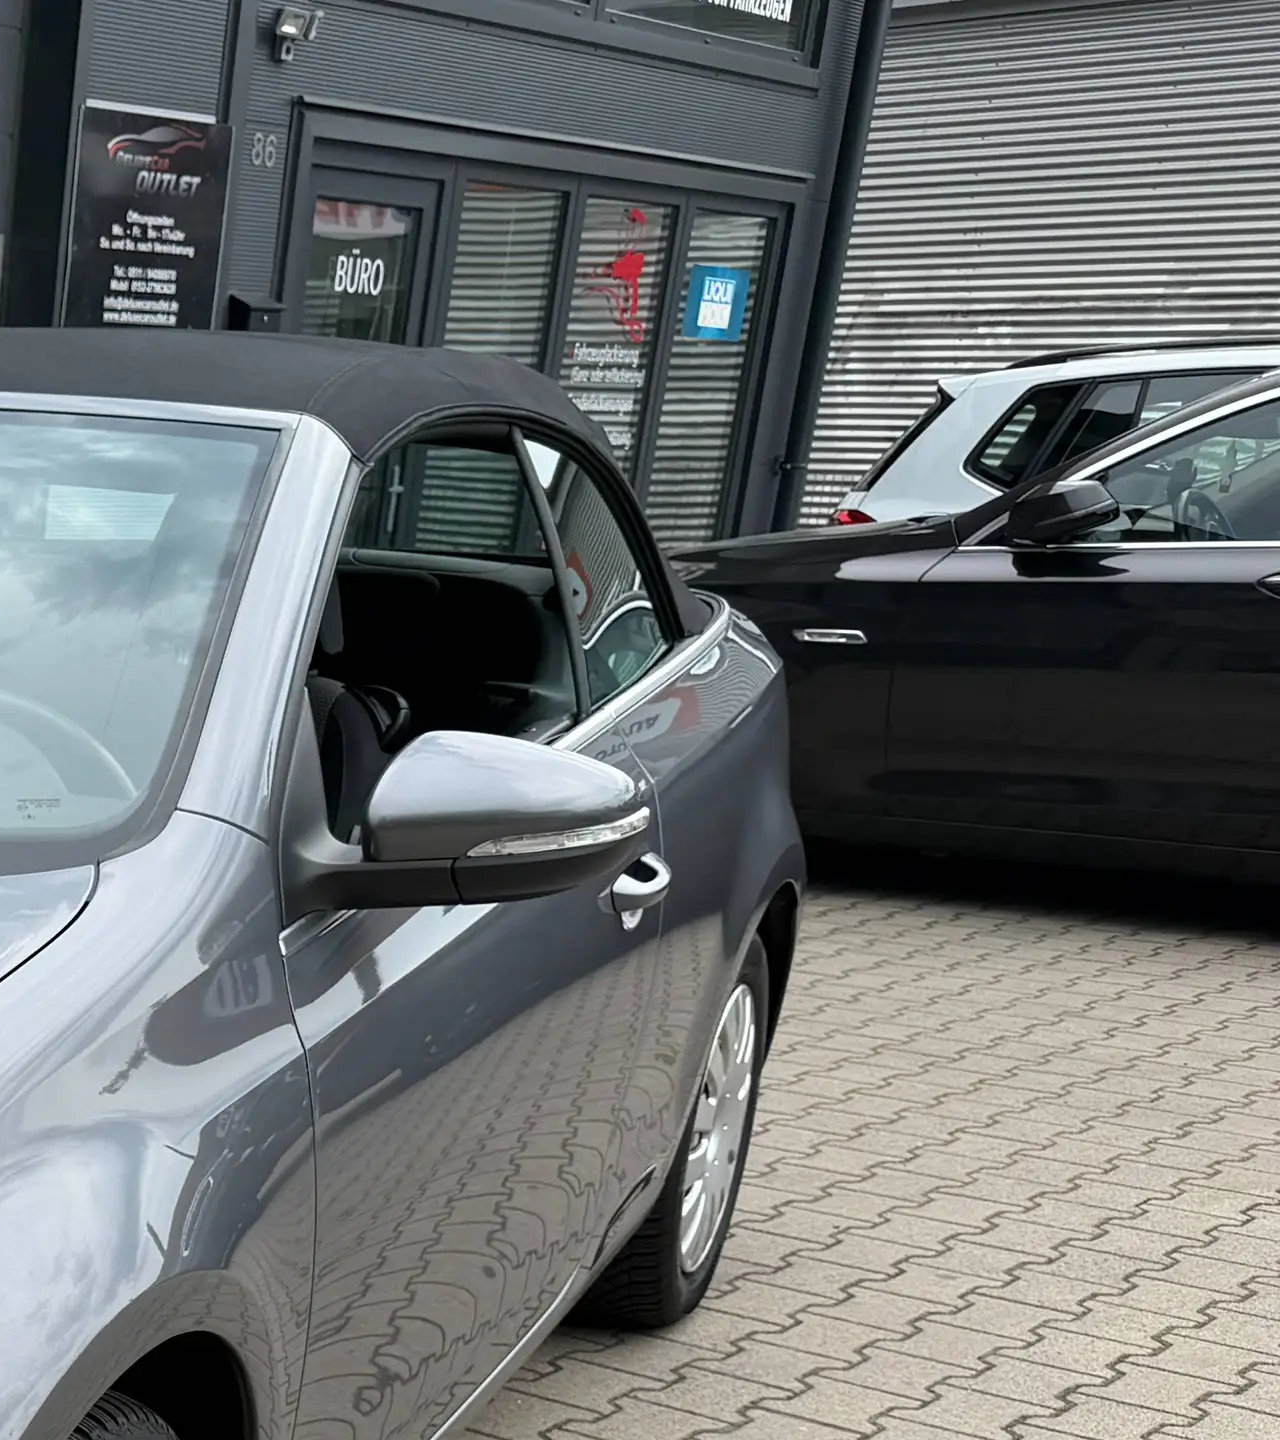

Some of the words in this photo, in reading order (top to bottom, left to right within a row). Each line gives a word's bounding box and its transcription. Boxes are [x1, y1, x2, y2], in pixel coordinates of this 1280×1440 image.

[251, 131, 278, 168] 86
[134, 169, 203, 199] OUTLET
[334, 248, 385, 296] BÜRO
